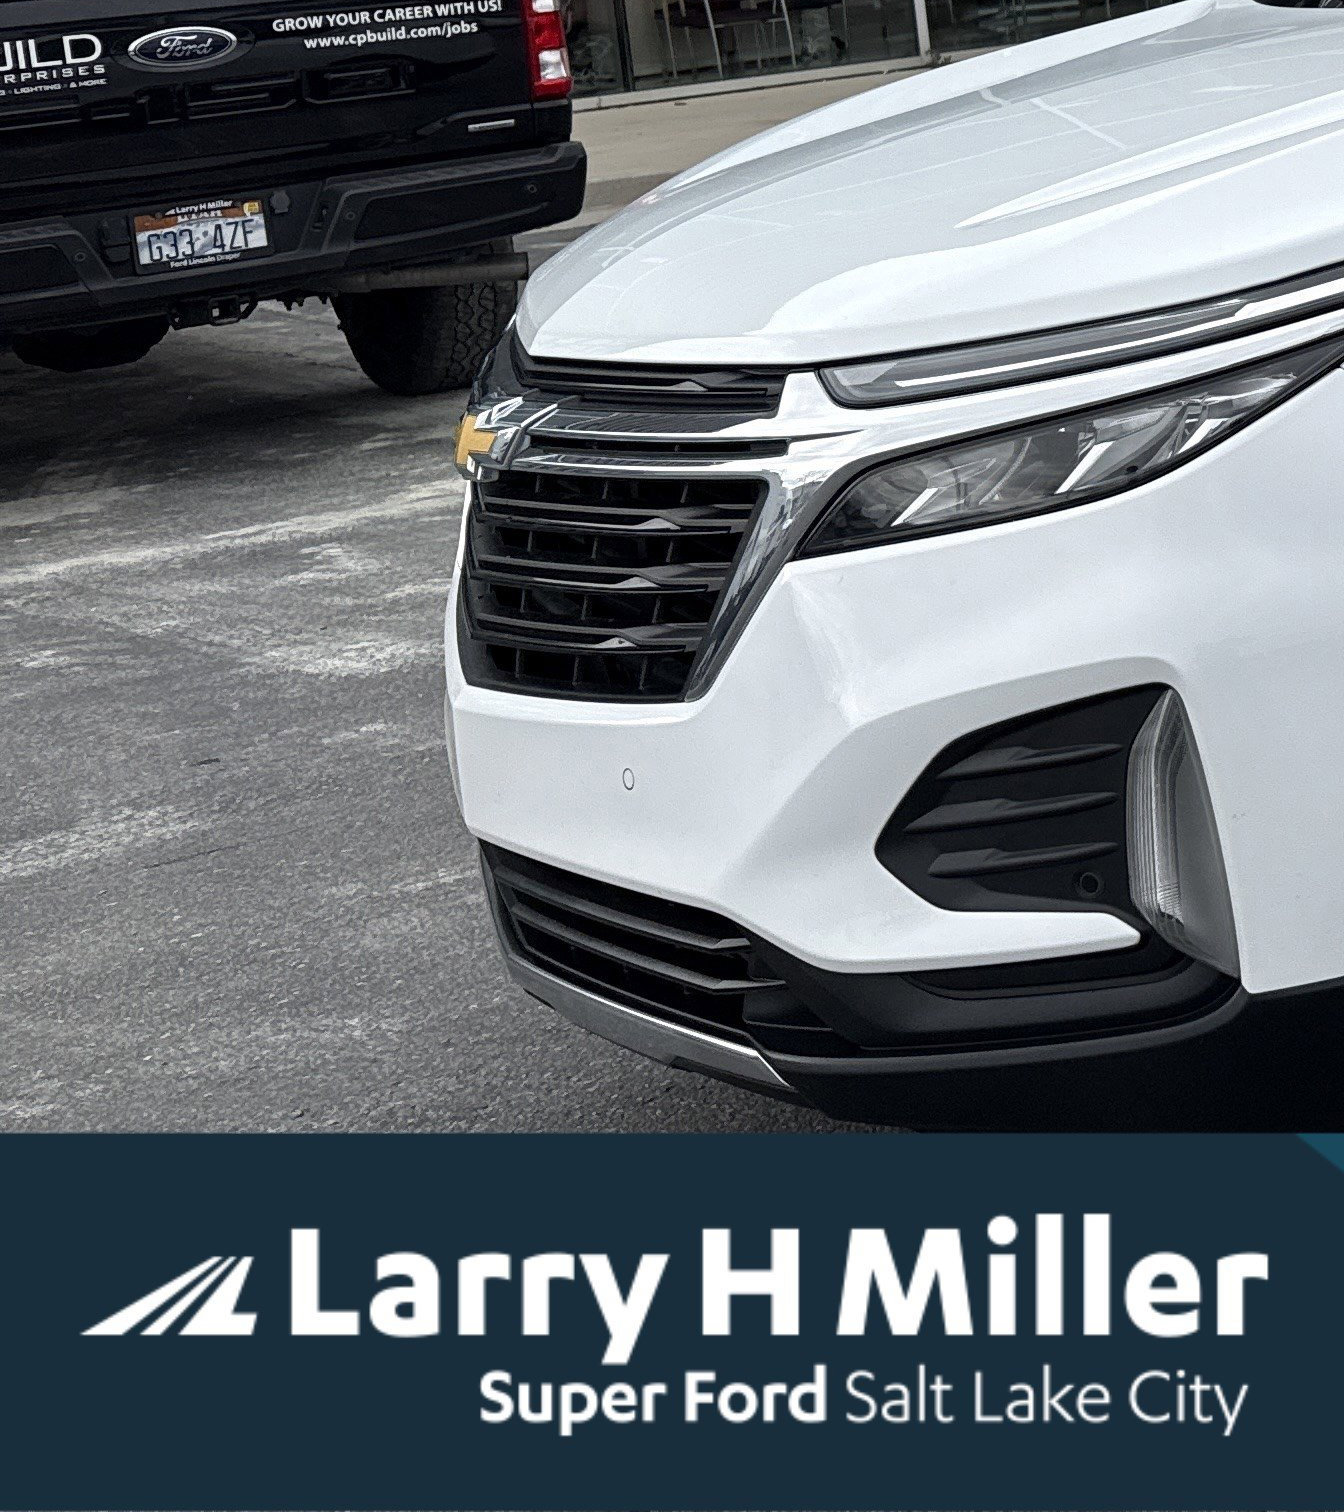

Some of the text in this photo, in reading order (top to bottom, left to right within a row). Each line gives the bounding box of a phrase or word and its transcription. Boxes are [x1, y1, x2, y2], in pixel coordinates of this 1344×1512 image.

[272, 16, 323, 32] GROW
[326, 11, 371, 27] YOUR
[373, 5, 433, 23] CAREER
[434, 1, 475, 17] WITH
[156, 34, 213, 59] Ford
[303, 20, 478, 49] www.cpbuild.com/jobs
[175, 205, 199, 214] Larry
[207, 199, 233, 209] Miller
[213, 219, 255, 252] 4ZF
